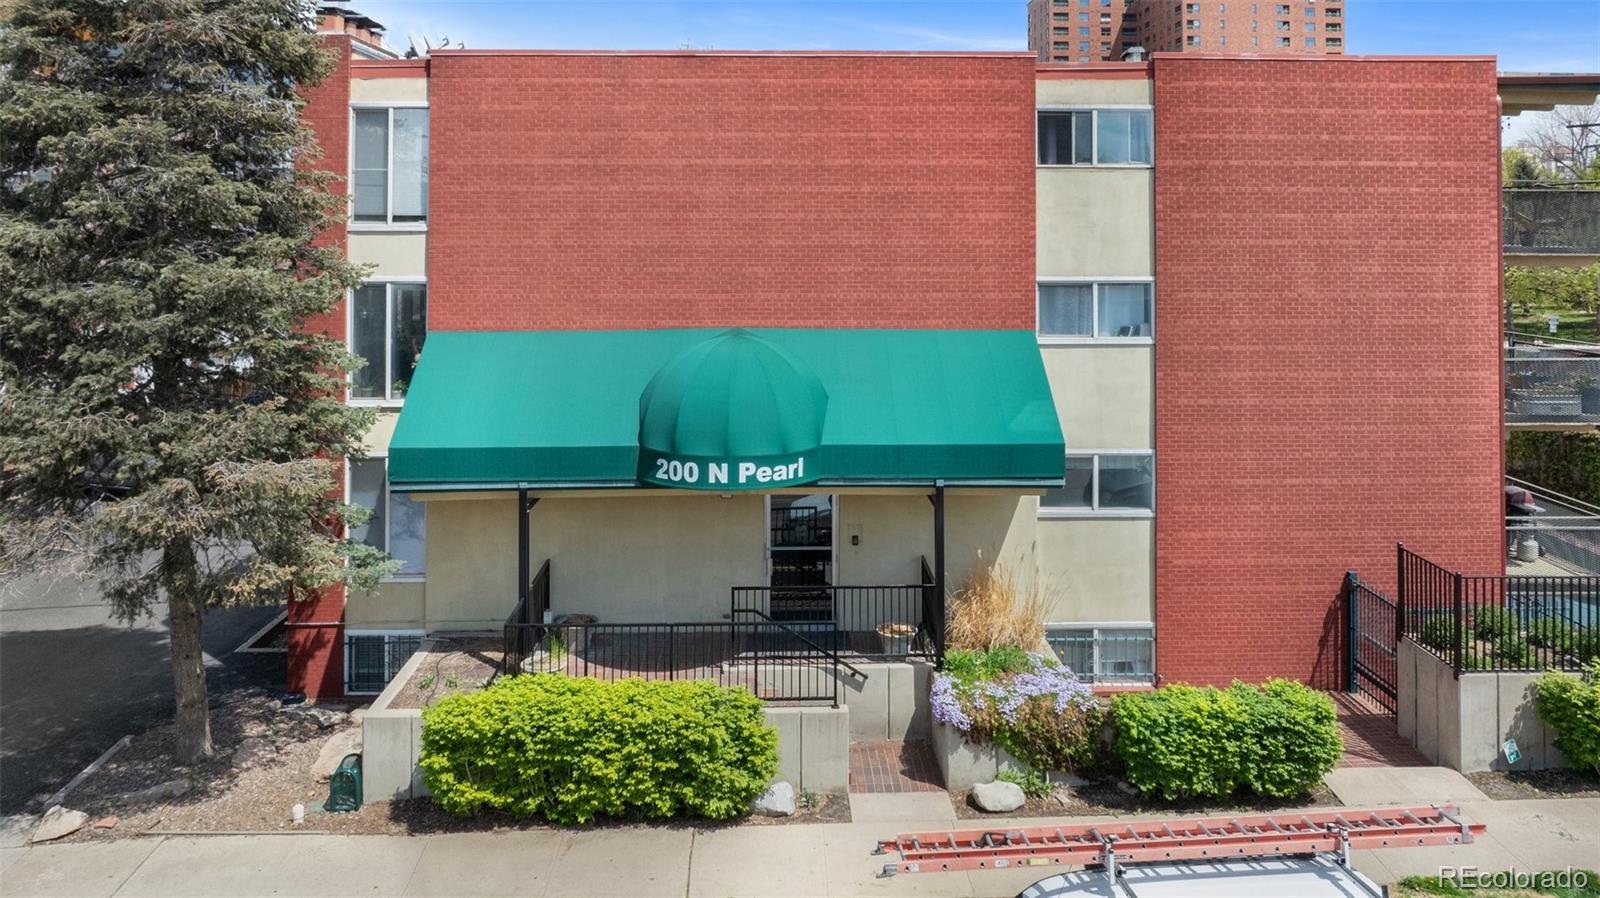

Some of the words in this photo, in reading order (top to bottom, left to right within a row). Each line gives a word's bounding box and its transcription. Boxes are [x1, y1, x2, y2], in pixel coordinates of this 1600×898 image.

[656, 458, 699, 483] 200
[708, 463, 728, 483] N
[738, 457, 804, 483] Pearl
